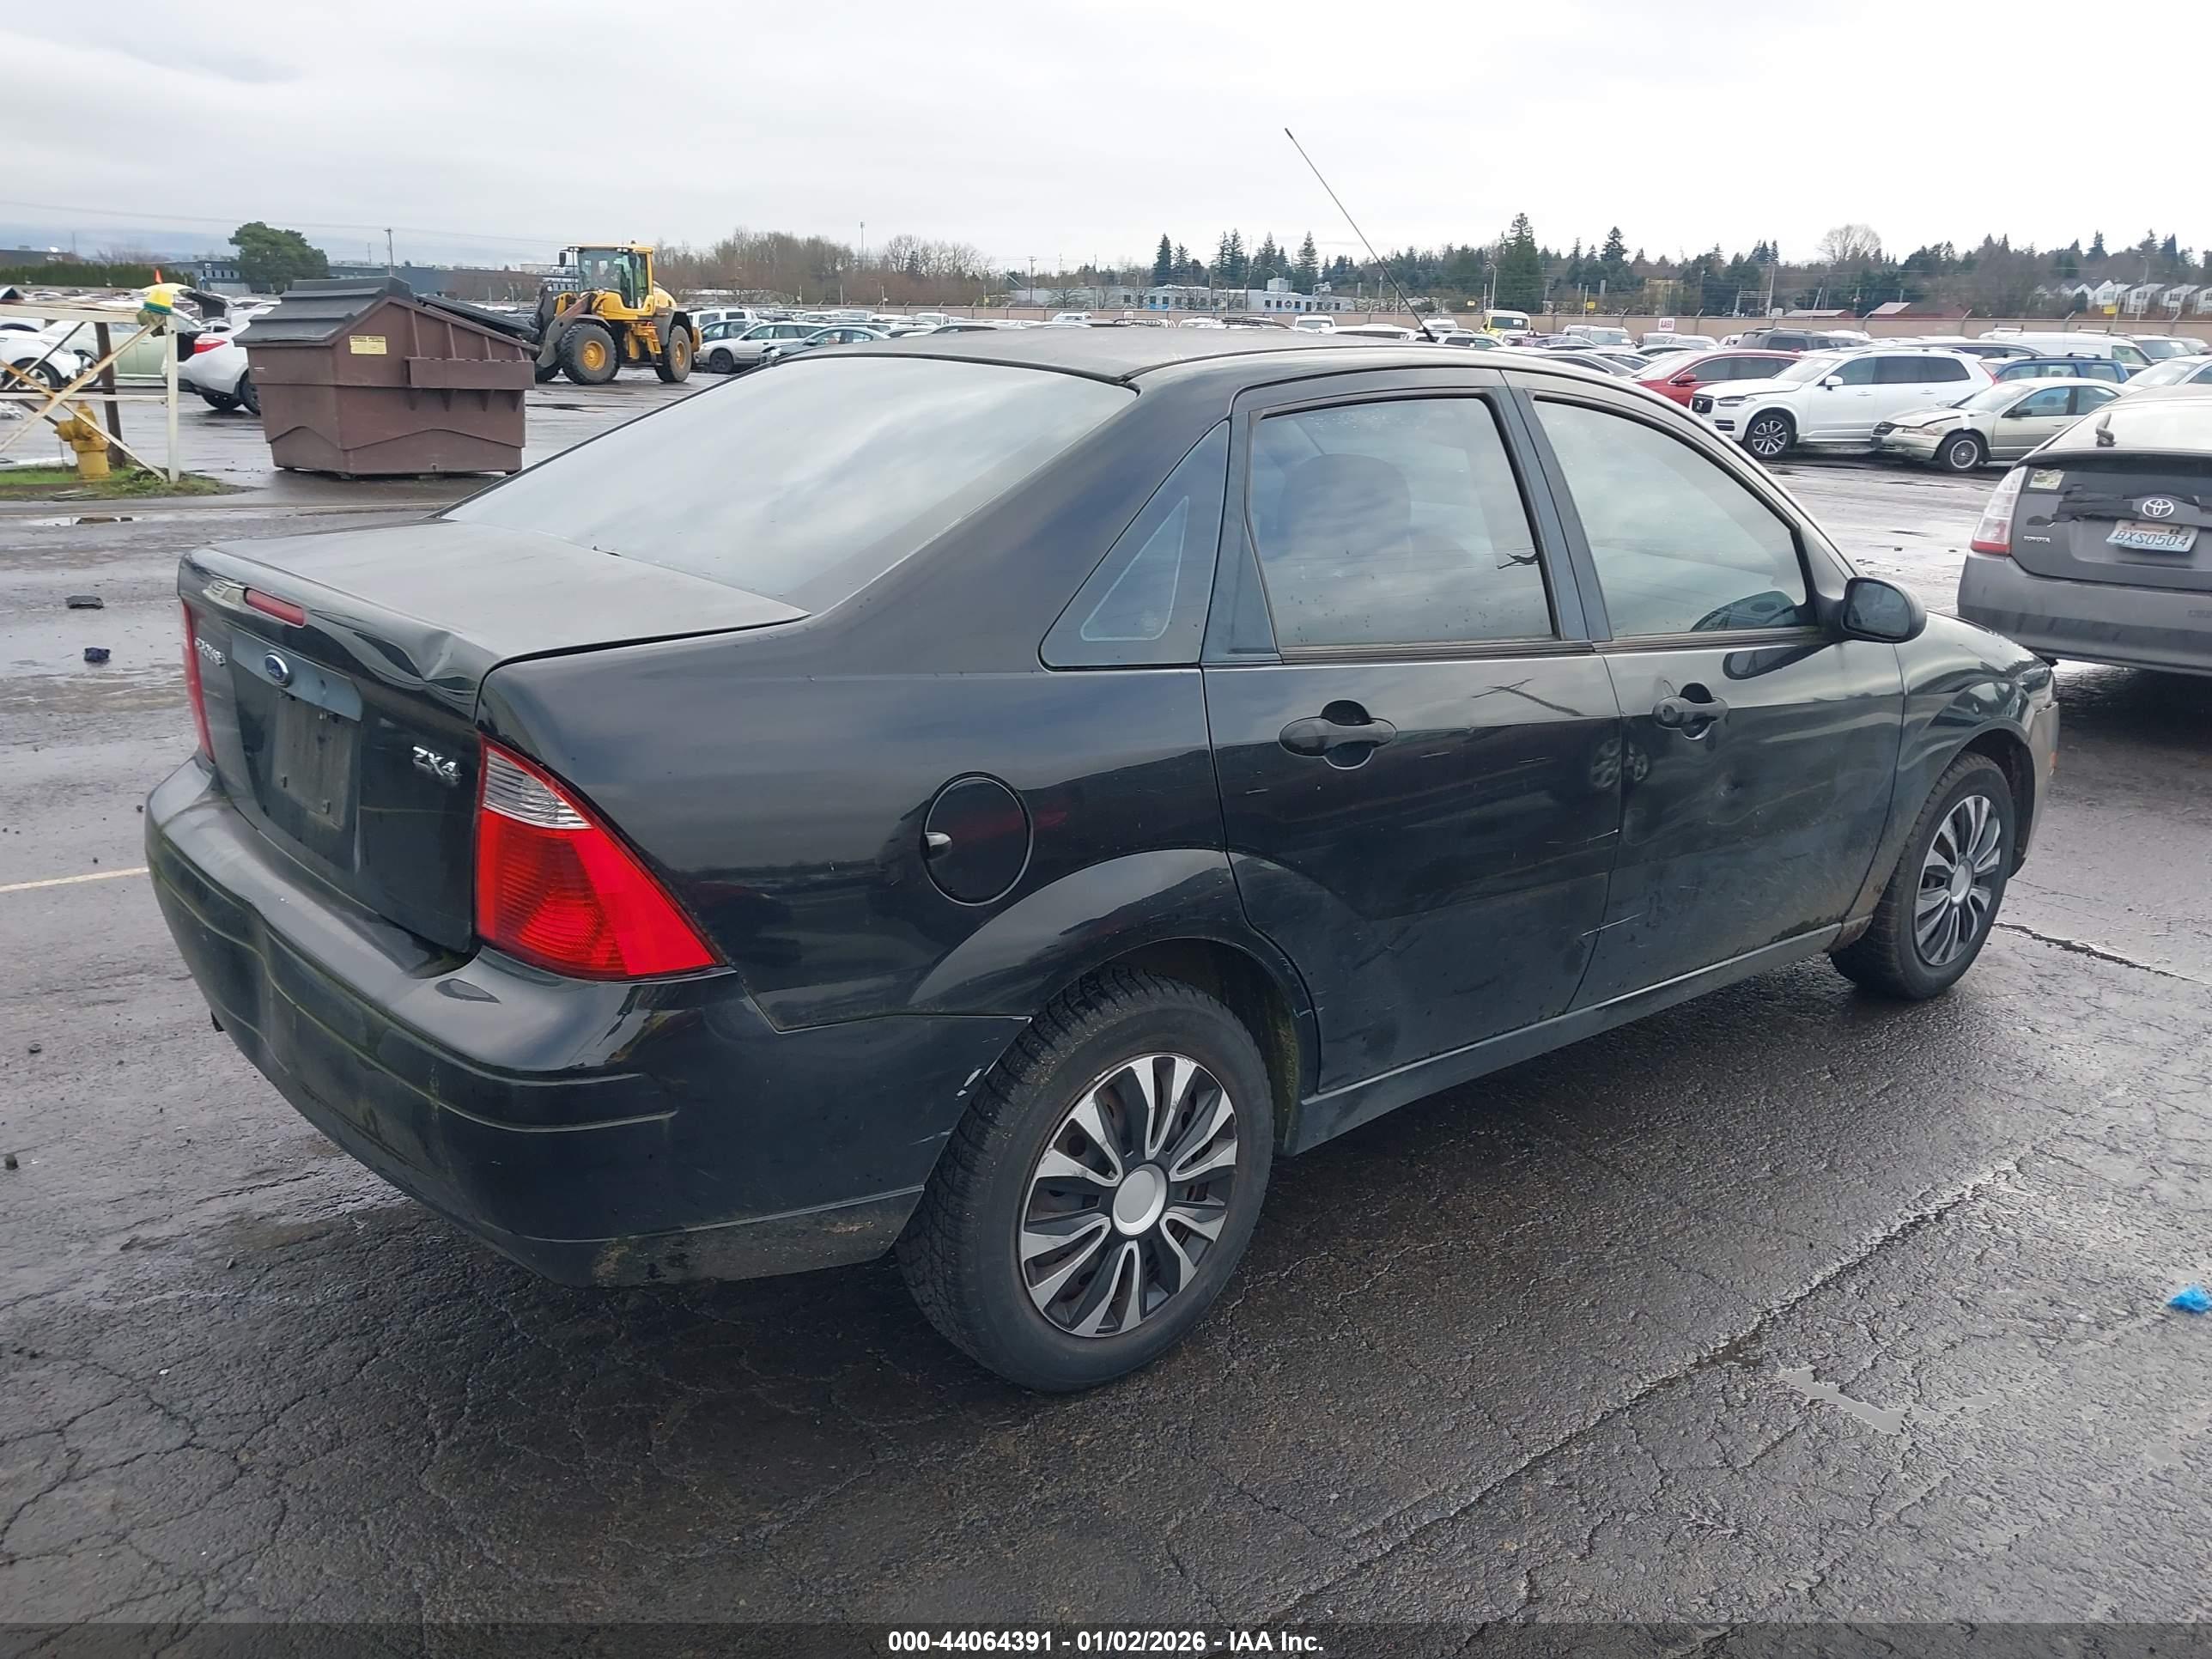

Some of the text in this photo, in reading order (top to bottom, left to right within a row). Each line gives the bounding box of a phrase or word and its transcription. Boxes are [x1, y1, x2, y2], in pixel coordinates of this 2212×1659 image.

[2023, 535, 2051, 544] TOYOTA
[2115, 530, 2191, 547] BXS0504
[412, 745, 464, 781] ZX4
